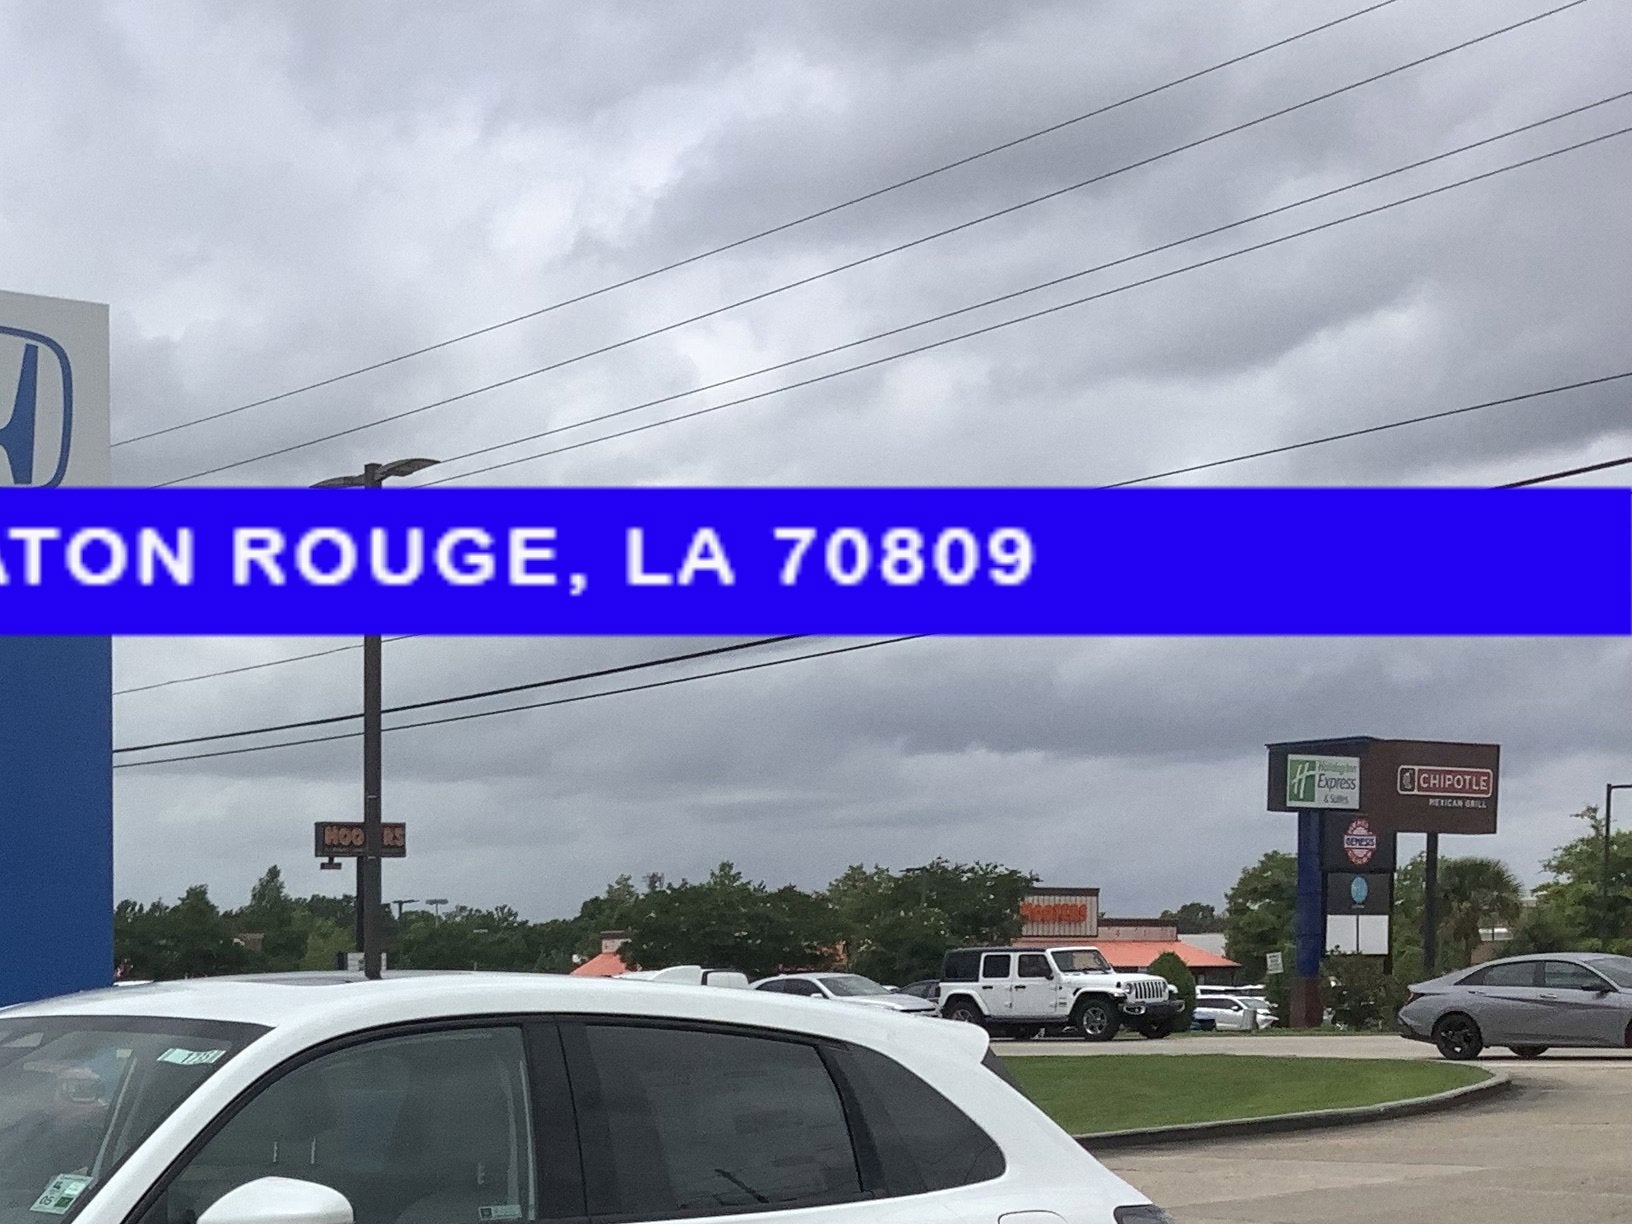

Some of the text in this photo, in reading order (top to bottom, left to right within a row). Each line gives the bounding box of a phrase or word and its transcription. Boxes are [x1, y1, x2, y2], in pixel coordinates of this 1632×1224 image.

[1317, 773, 1356, 791] Express
[1419, 773, 1488, 790] CHIPOTLE
[1429, 798, 1464, 808] MEXICAN
[324, 826, 404, 846] HOORS
